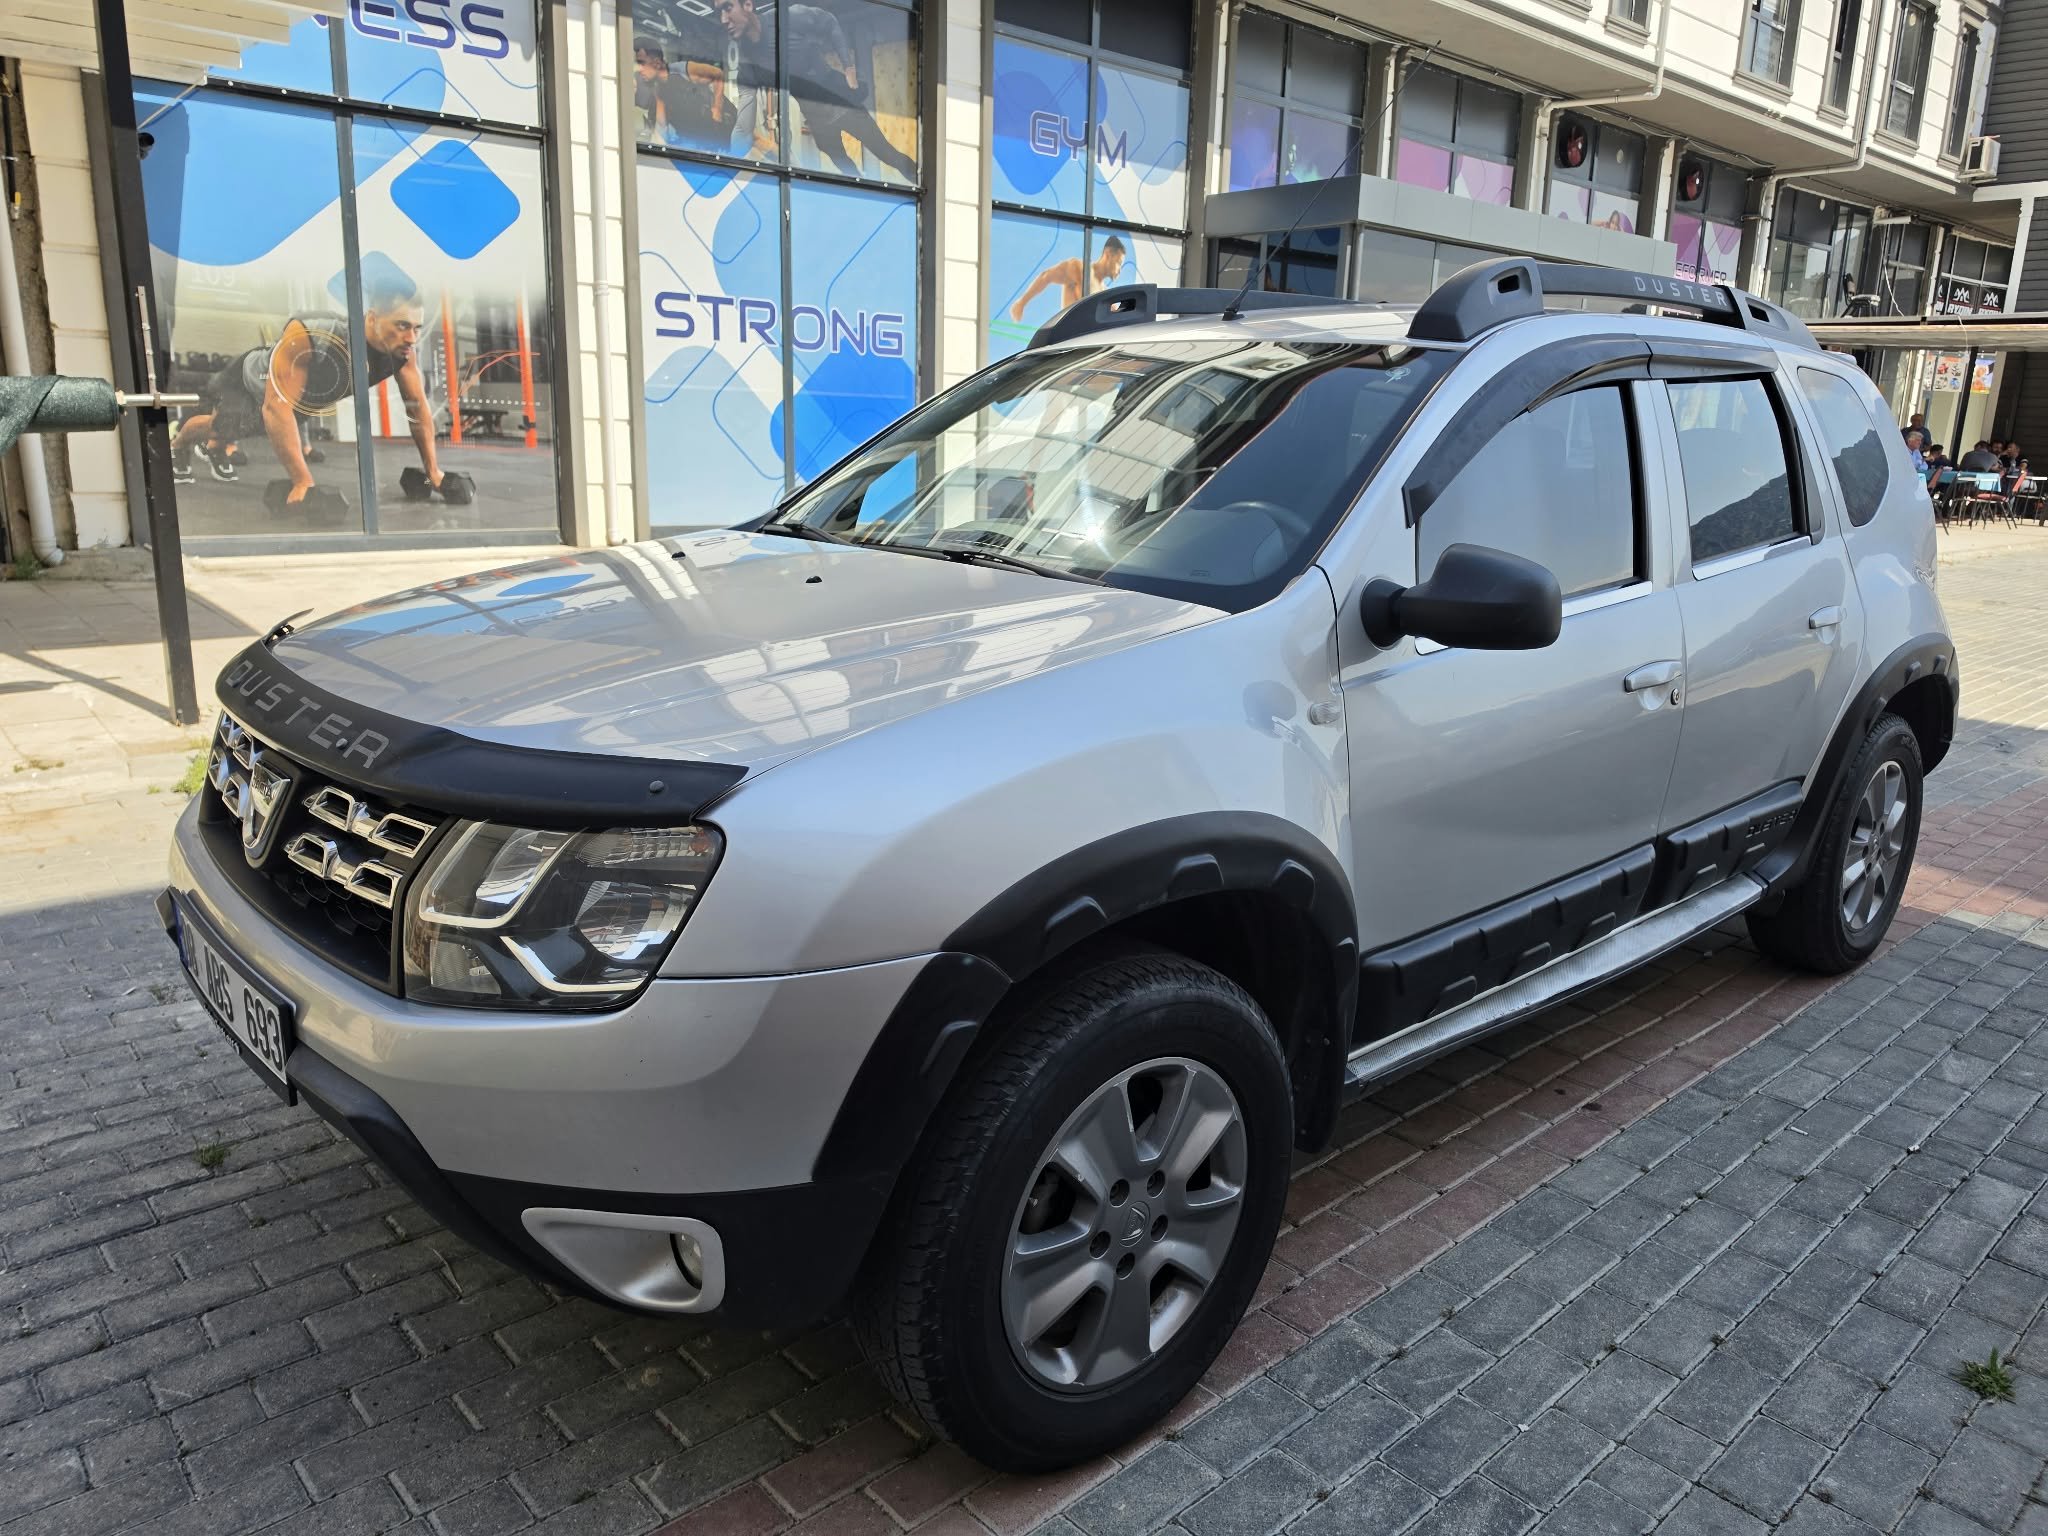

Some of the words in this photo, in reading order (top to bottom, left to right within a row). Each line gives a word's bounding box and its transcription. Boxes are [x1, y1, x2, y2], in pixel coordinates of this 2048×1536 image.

[1030, 110, 1128, 169] GYM
[654, 291, 904, 357] STRONG
[1633, 276, 1728, 307] DUSTER
[225, 659, 391, 769] DUSTER
[243, 985, 284, 1073] 693
